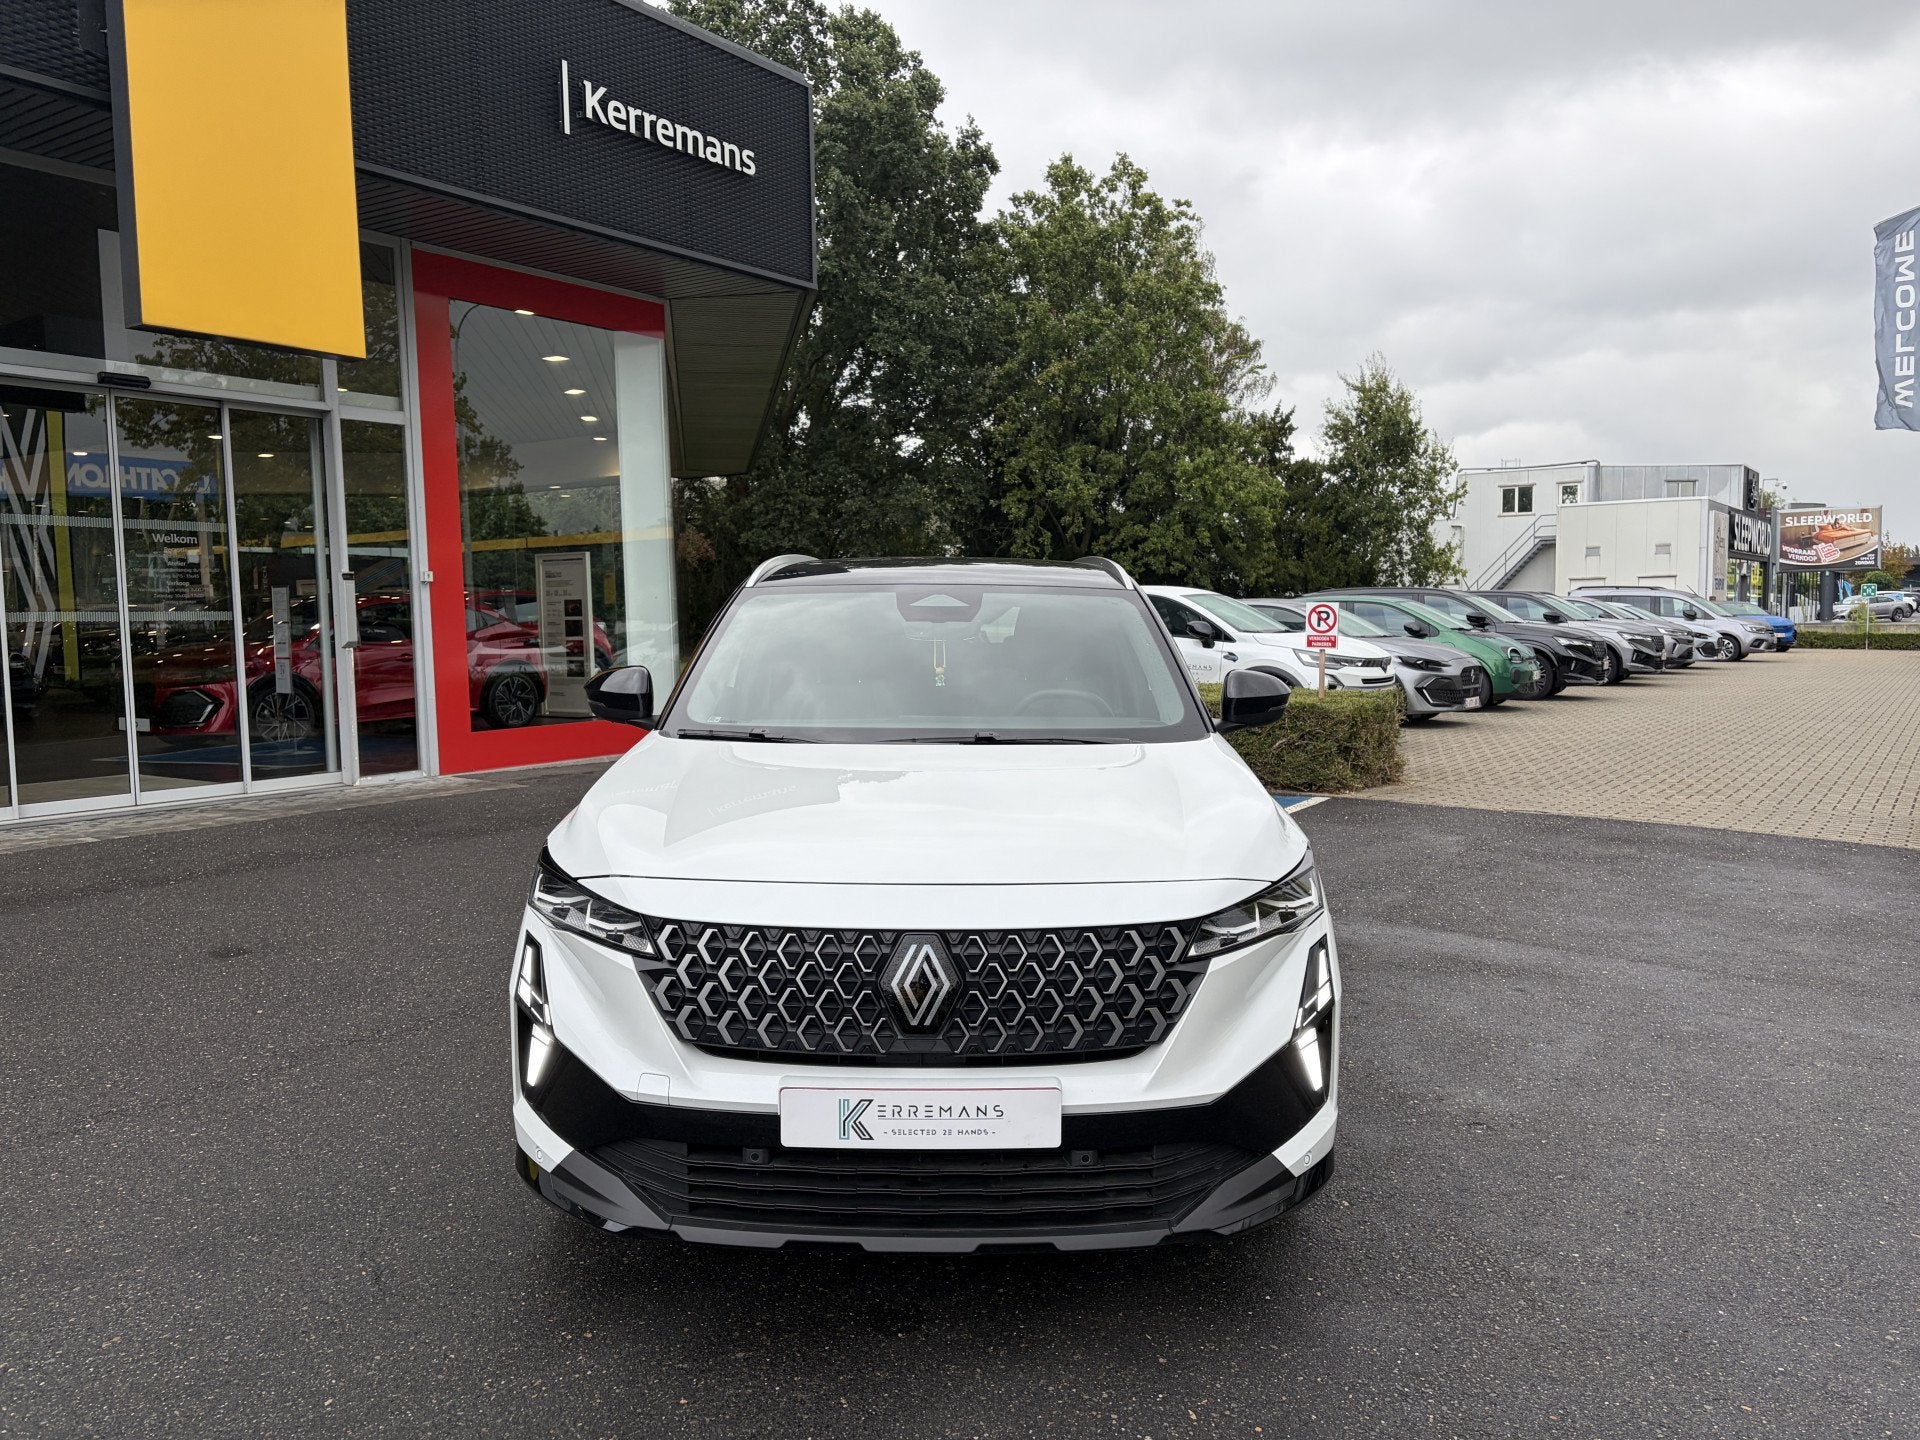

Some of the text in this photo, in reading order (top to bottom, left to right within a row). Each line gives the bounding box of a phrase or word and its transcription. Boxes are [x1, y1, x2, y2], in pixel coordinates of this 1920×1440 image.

[583, 79, 757, 176] Kerremans
[1785, 512, 1874, 527] SLEEPWORLD
[152, 533, 198, 544] Welkom
[1734, 513, 1772, 555] SLEEPWORLD
[1782, 545, 1816, 556] VOORRAAD
[1788, 553, 1818, 562] VERKOOP
